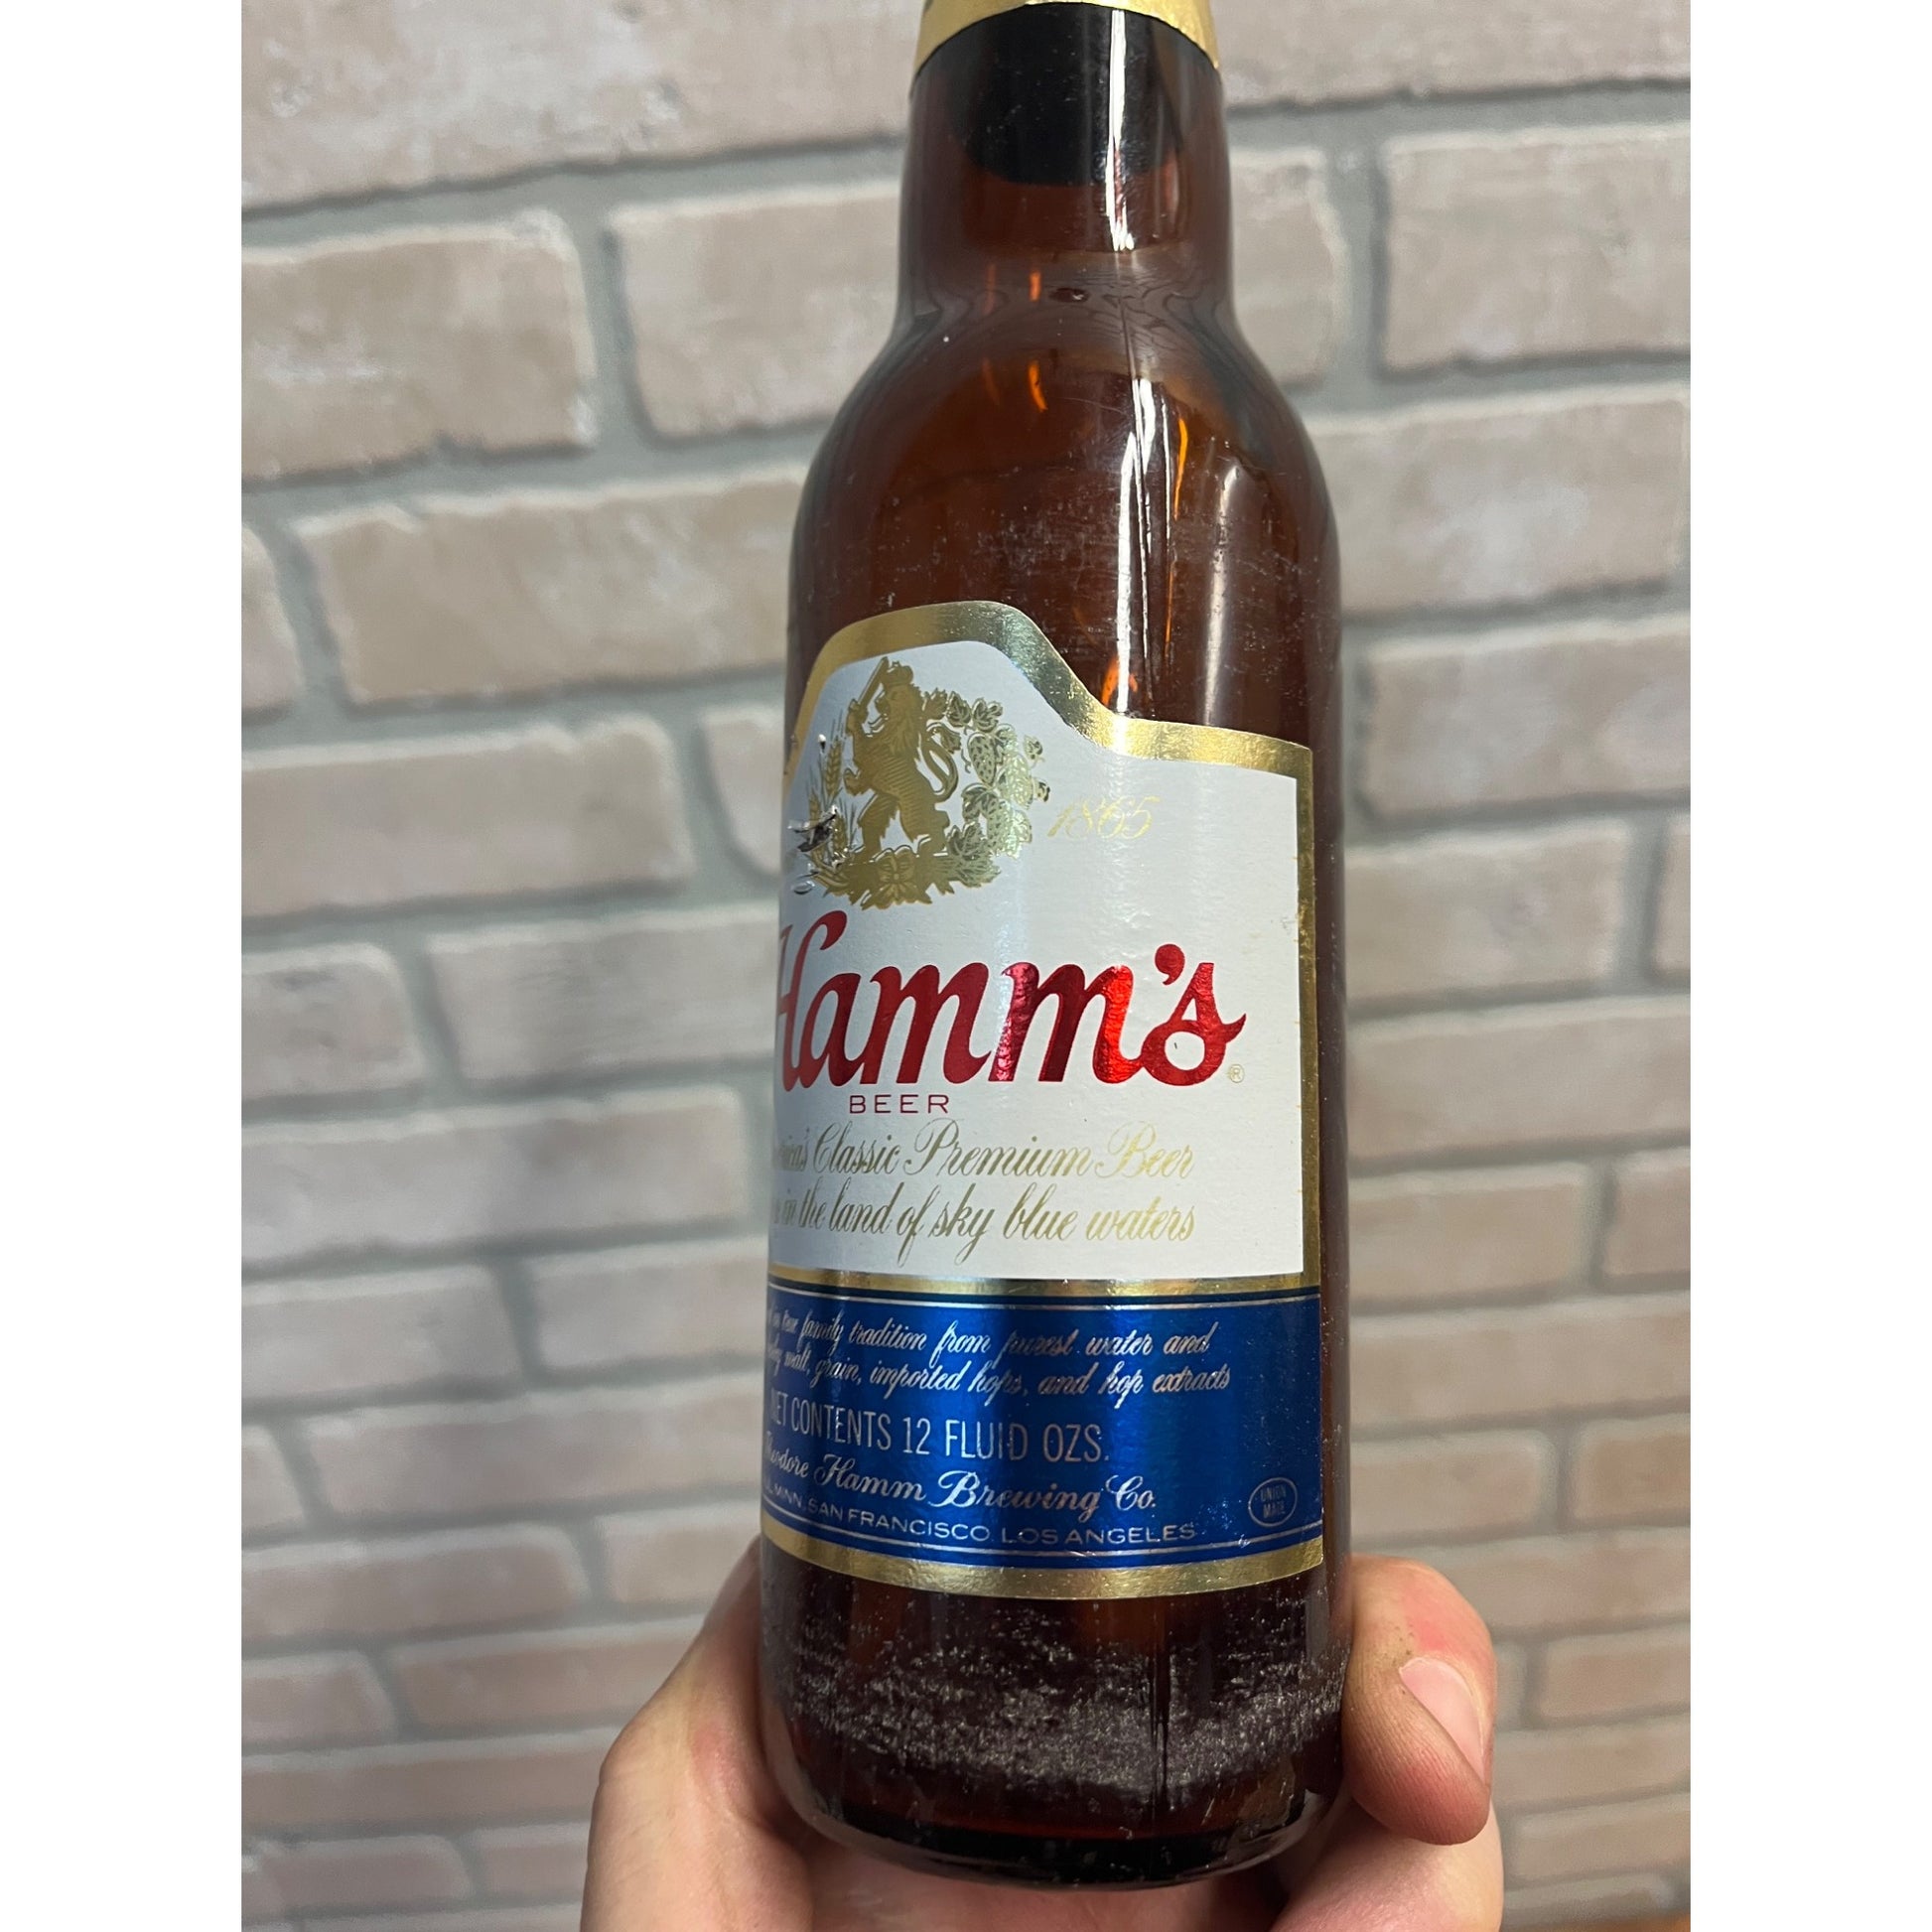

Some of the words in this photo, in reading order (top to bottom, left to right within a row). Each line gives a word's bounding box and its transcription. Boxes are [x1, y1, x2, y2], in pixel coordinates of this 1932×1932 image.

[1046, 795, 1161, 840] 1865
[778, 910, 1246, 1092] Hamm's
[849, 1094, 949, 1114] BEER
[813, 1120, 900, 1174] Classic
[902, 1118, 1092, 1177] Premium
[1095, 1121, 1195, 1179] Beer
[798, 1175, 827, 1230] the
[828, 1176, 904, 1235] land
[896, 1183, 941, 1269] of
[928, 1181, 996, 1266] sky
[1002, 1181, 1079, 1241] blue
[1085, 1196, 1195, 1242] waters
[797, 1309, 845, 1356] family
[849, 1316, 927, 1351] tradition
[929, 1319, 992, 1369] from
[992, 1328, 1079, 1369] purest
[1085, 1328, 1154, 1356] water
[1163, 1321, 1219, 1355] and
[810, 1356, 862, 1389] grain,
[870, 1360, 972, 1400] imported
[1038, 1361, 1100, 1395] and
[1097, 1360, 1145, 1410] hop
[1152, 1363, 1231, 1394] extracts
[791, 1397, 892, 1451] CONTENTS
[902, 1416, 931, 1455] 12
[945, 1419, 1029, 1461] FLUID
[1043, 1423, 1110, 1463] OZS.
[814, 1453, 927, 1502] Hamm
[927, 1469, 1100, 1523] Brewing
[1105, 1474, 1158, 1512] Co.
[808, 1497, 844, 1521] SAN
[1001, 1526, 1058, 1545] LOS
[1063, 1521, 1196, 1546] ANGELES
